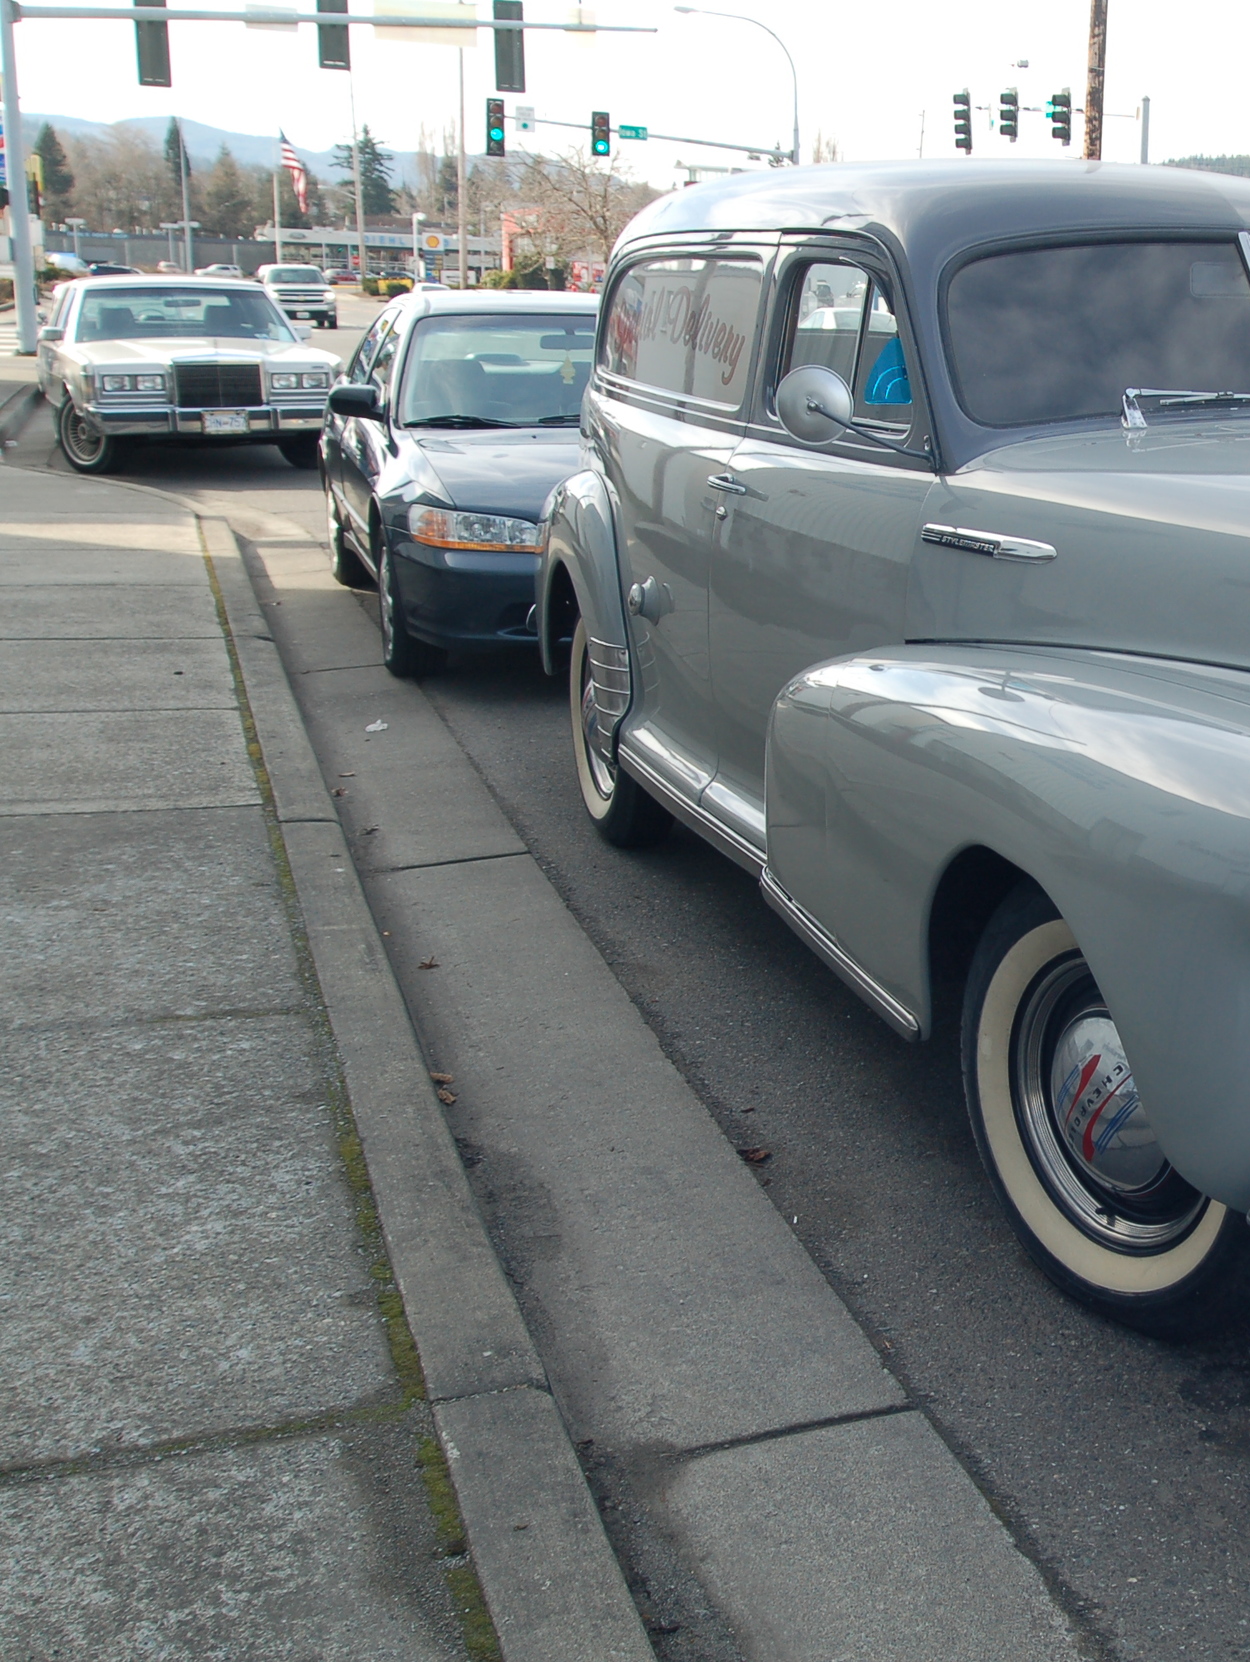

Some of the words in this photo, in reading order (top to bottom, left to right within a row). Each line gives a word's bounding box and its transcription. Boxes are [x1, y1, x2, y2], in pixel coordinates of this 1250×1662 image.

[364, 234, 406, 246] DIEHL
[667, 285, 746, 386] Delivery
[941, 535, 994, 553] STYLEMASTER
